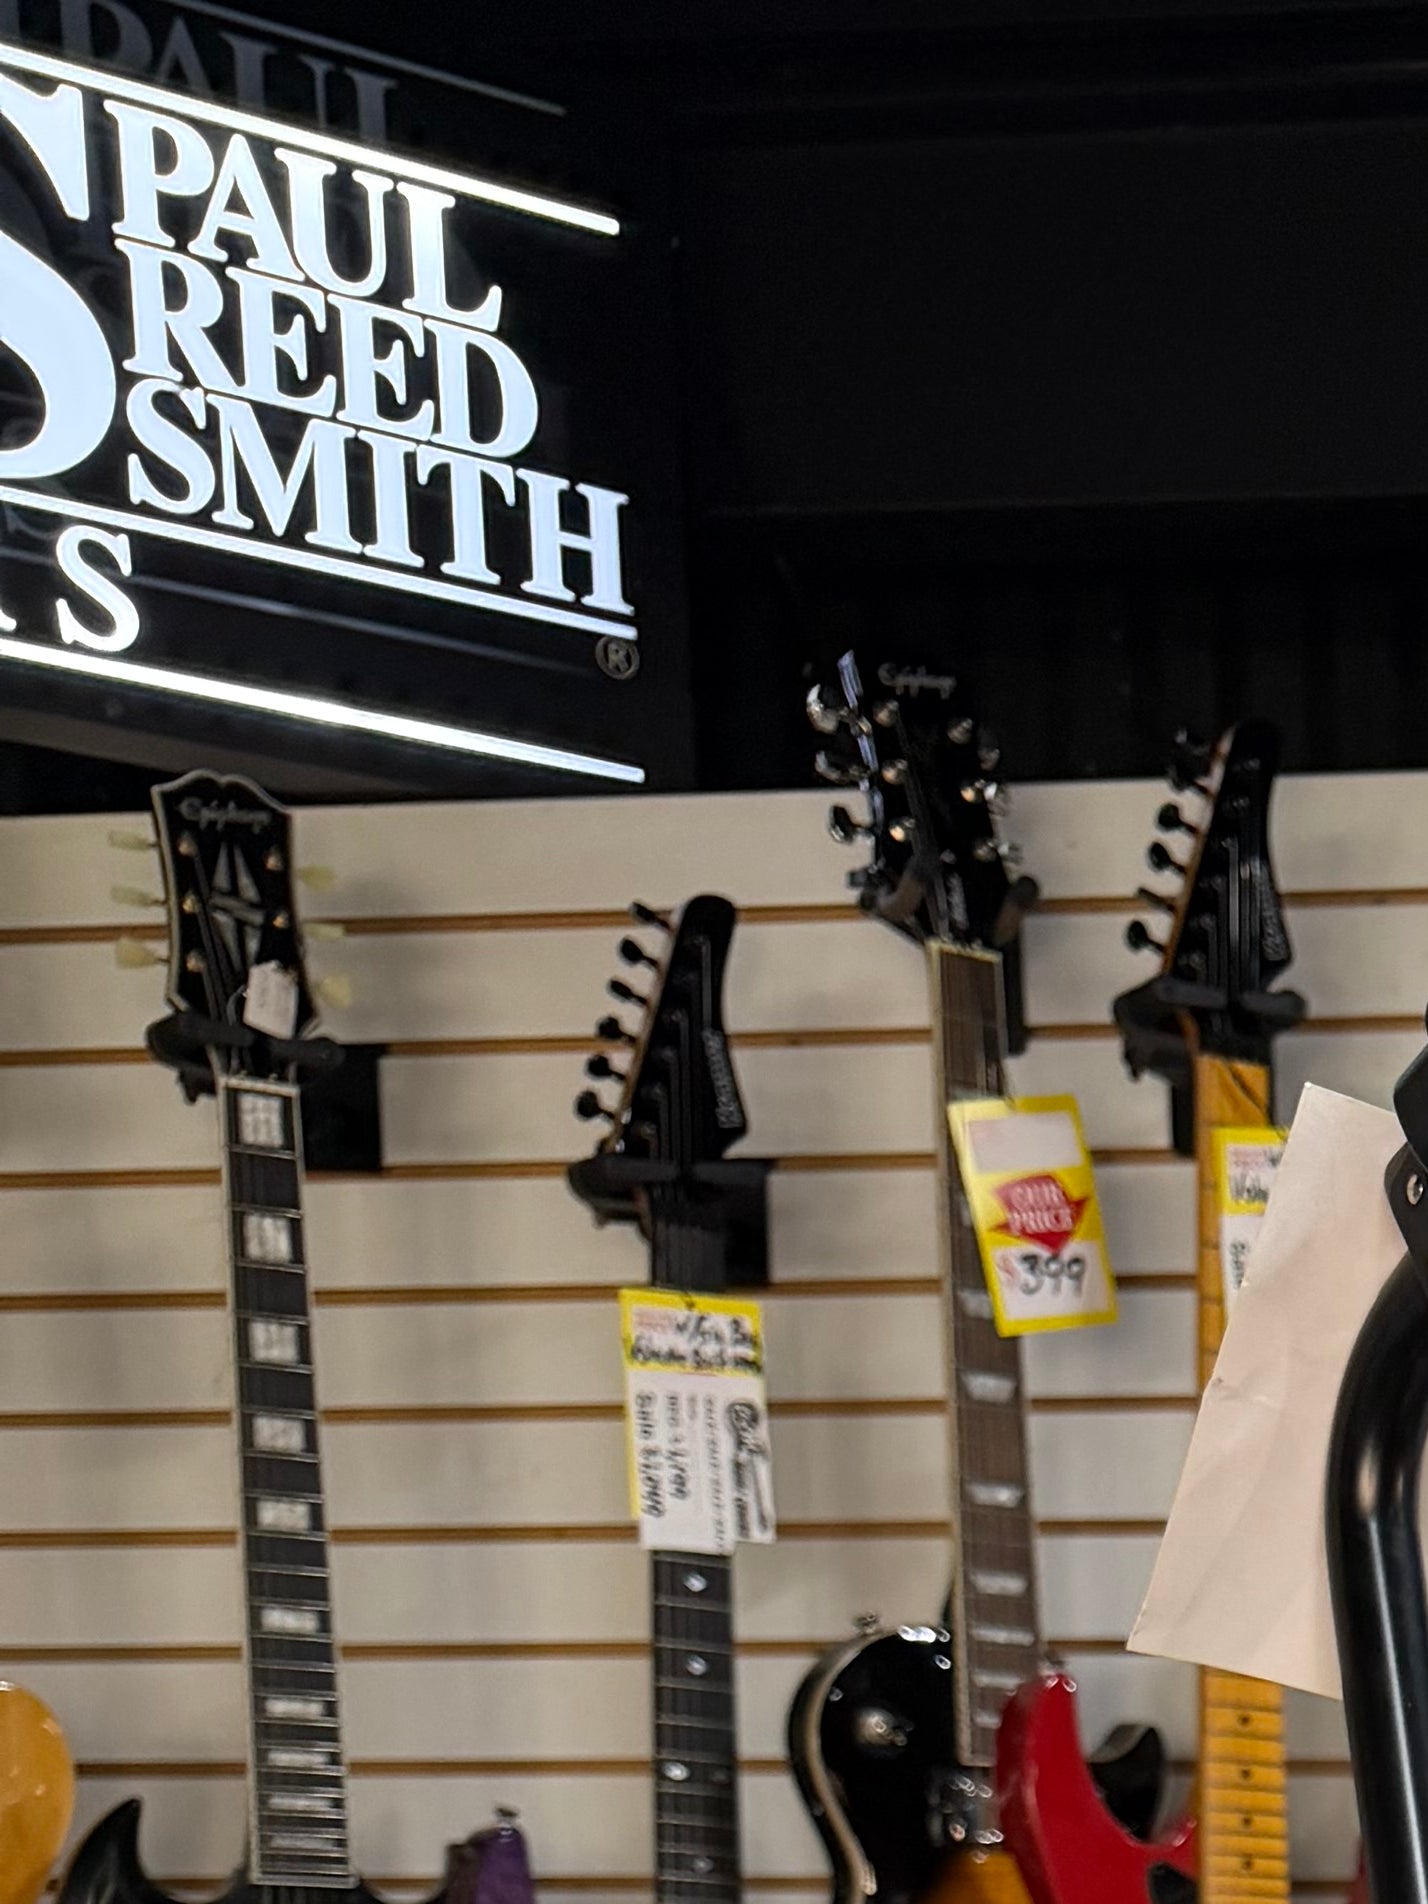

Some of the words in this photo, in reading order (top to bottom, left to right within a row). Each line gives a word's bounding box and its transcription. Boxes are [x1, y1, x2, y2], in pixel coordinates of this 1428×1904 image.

[103, 98, 503, 333] PAUL
[114, 237, 540, 460] REED
[124, 377, 636, 617] SMITH
